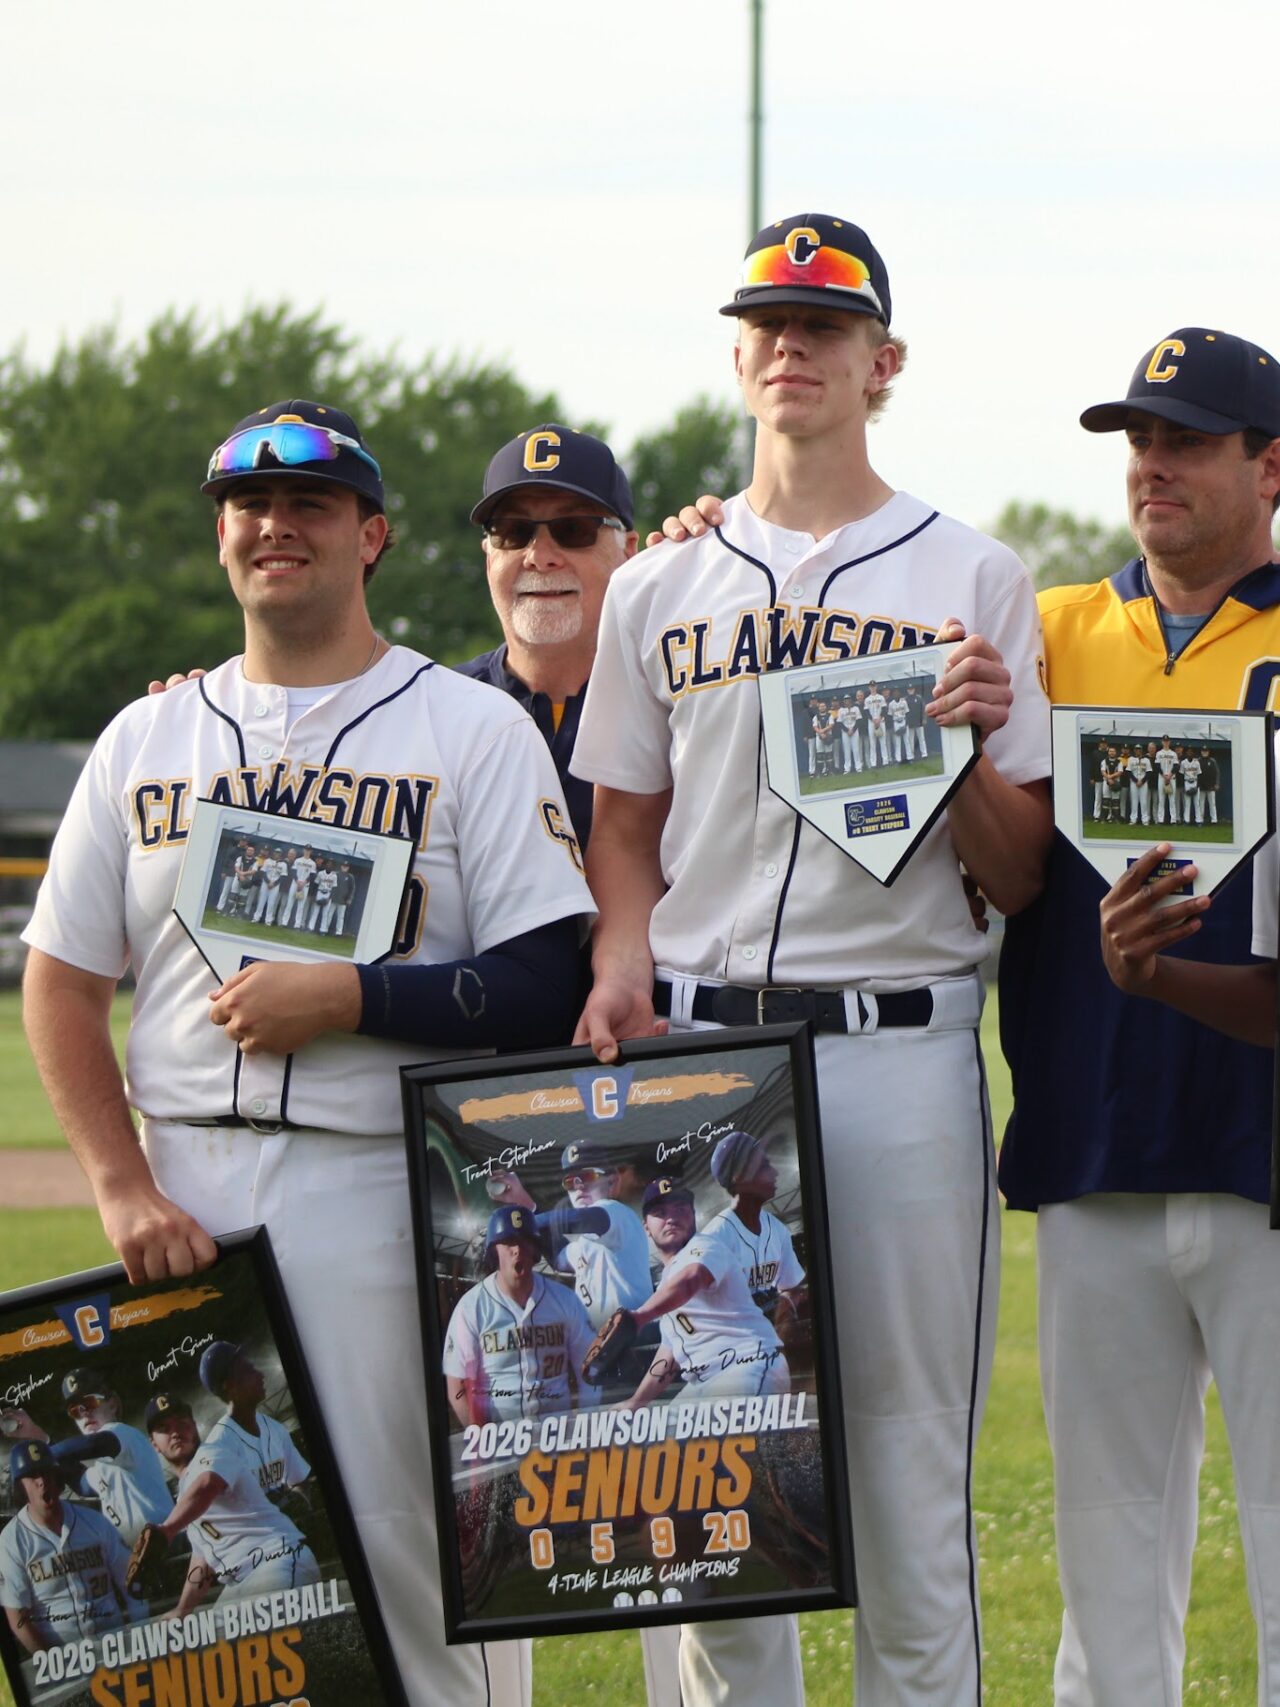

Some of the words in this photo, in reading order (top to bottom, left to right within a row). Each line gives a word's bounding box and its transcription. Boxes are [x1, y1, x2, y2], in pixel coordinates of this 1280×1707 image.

[784, 227, 820, 265] C
[1145, 339, 1186, 383] C
[523, 431, 561, 473] C
[531, 1091, 579, 1111] Clawson
[591, 1076, 618, 1120] C
[631, 1082, 674, 1104] Trojans
[460, 1156, 499, 1185] Trent
[499, 1138, 556, 1168] Stephan
[567, 1146, 580, 1164] C
[656, 1131, 695, 1164] Grant
[696, 1120, 735, 1143] Sims
[658, 1178, 673, 1195] C
[510, 1210, 523, 1229] C
[22, 1329, 67, 1347] Clawson
[74, 1305, 105, 1347] C
[111, 1306, 150, 1328] Trojans
[483, 1323, 565, 1354] CLAWSON
[461, 1417, 533, 1461] 2026
[539, 1405, 670, 1452] CLAWSON
[676, 1392, 811, 1440] BASEBALL
[514, 1437, 756, 1527] SENIORS
[529, 1528, 555, 1570] 0
[590, 1522, 616, 1564] 5
[649, 1516, 676, 1559] 9
[703, 1509, 750, 1555] 20
[28, 1545, 105, 1582] CLAWSON
[548, 1572, 598, 1595] 4-TIME
[602, 1567, 654, 1590] LEAGUE
[659, 1557, 740, 1585] CHAMPIONS
[33, 1646, 97, 1685] 2026
[102, 1615, 218, 1670] CLAWSON
[225, 1578, 347, 1637] BASEBALL
